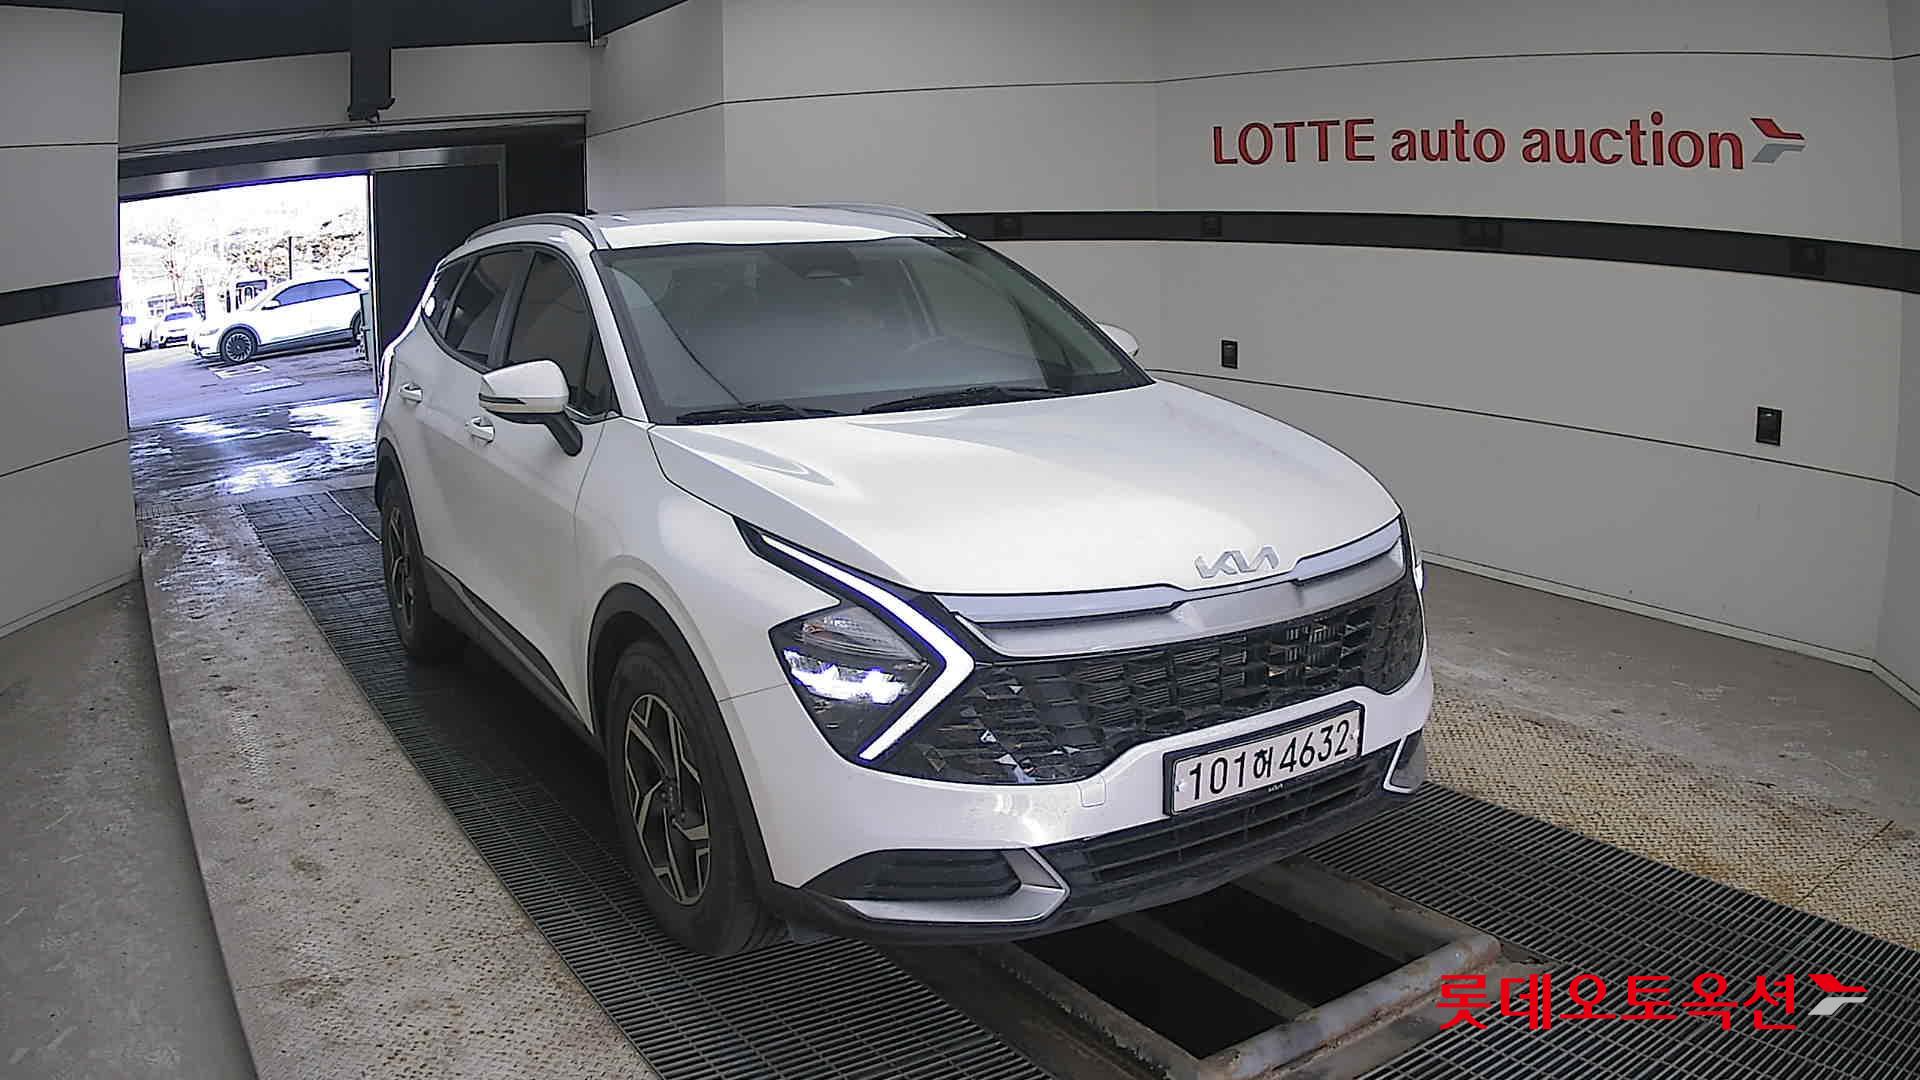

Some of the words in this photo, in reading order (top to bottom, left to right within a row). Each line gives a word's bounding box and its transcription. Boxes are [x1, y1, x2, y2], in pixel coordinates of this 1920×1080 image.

[1212, 118, 1376, 165] LOTTE
[1391, 119, 1506, 162] auto
[1521, 111, 1745, 170] auction
